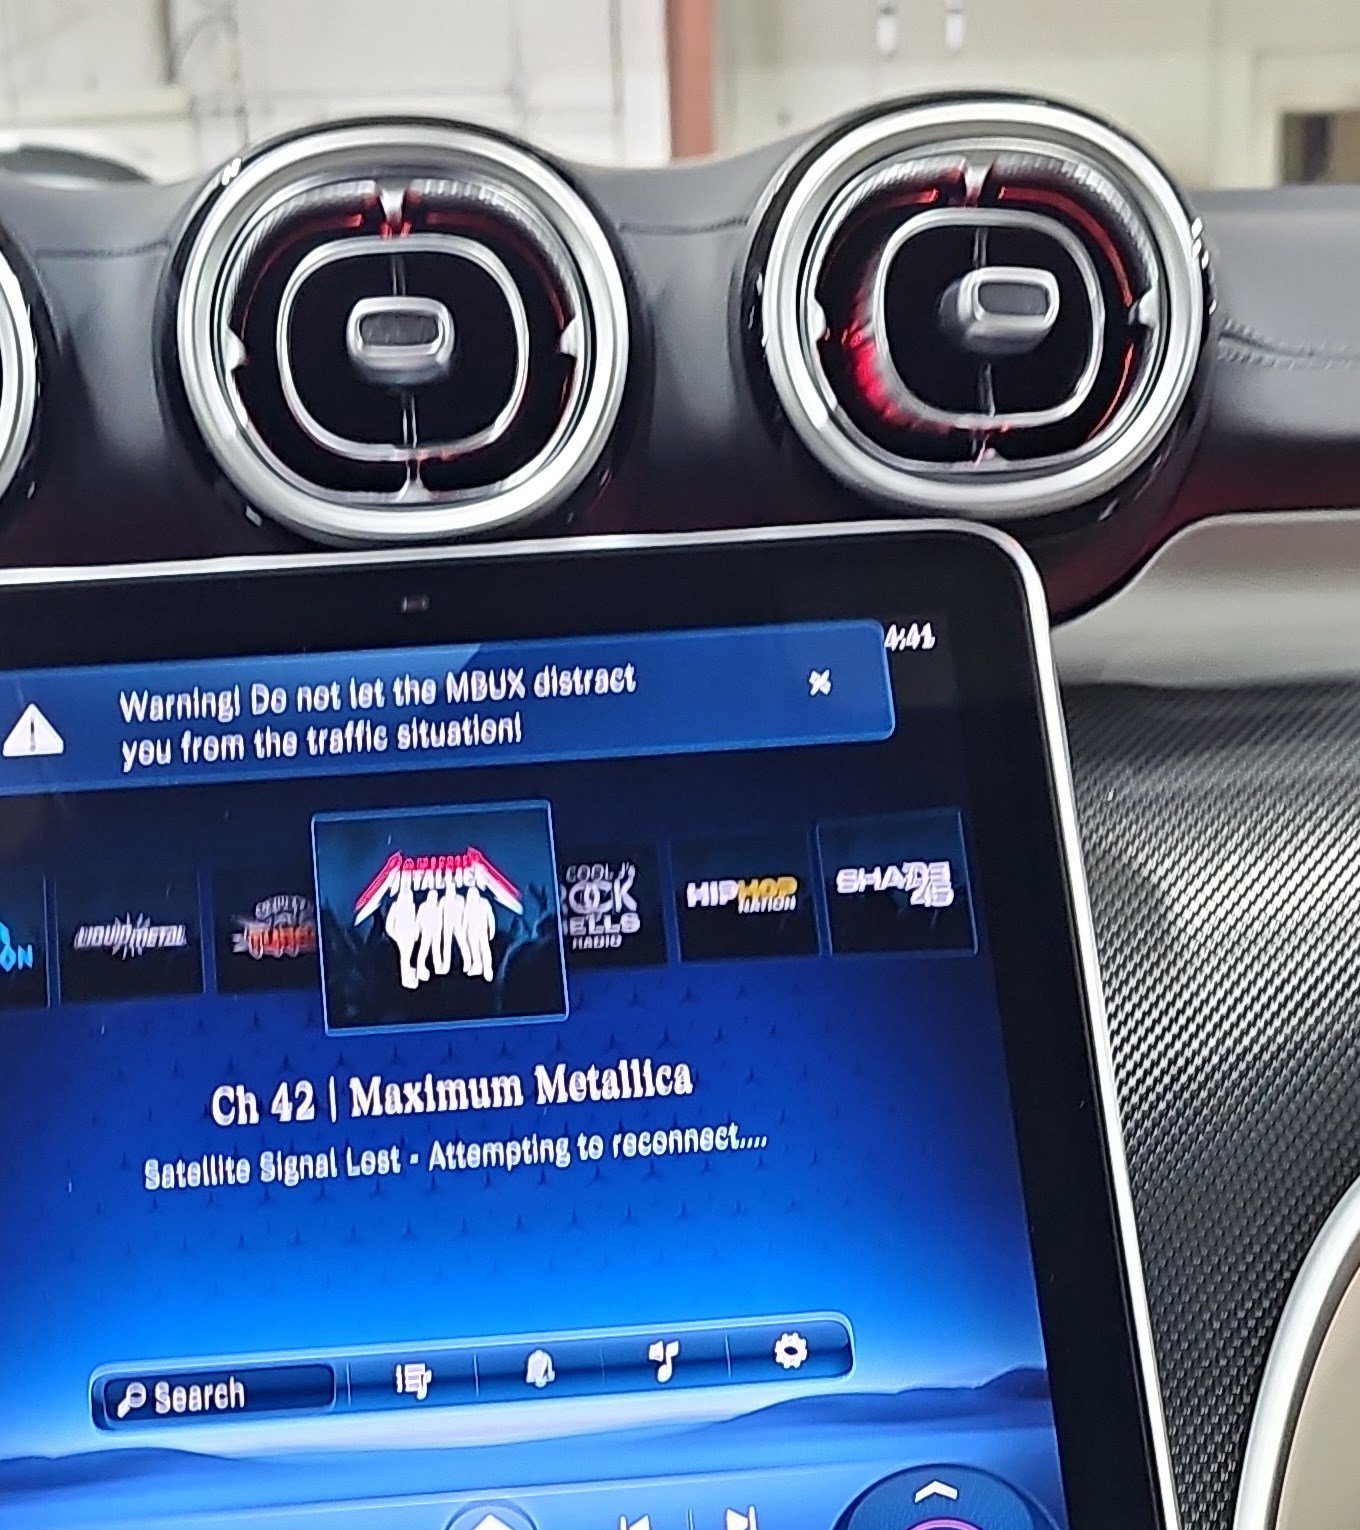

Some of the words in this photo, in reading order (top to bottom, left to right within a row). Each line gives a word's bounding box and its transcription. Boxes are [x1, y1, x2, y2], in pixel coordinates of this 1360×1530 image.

[119, 684, 241, 723] Warning!
[250, 683, 287, 716] Do
[297, 680, 341, 712] not
[348, 676, 385, 710] let
[392, 673, 437, 707] the
[445, 667, 526, 704] MBUX
[534, 662, 636, 698] distract
[122, 738, 171, 773] you
[180, 730, 244, 763] from
[254, 725, 298, 759] the
[306, 719, 388, 756] traffic
[397, 711, 522, 750] situation!
[211, 1084, 260, 1126] Ch
[271, 1080, 316, 1122] 42
[349, 1072, 524, 1118] Maximum
[534, 1058, 693, 1105] Metallica
[144, 1154, 251, 1190] Satellite
[260, 1146, 338, 1187] Signal
[347, 1145, 402, 1177] Lost
[429, 1133, 570, 1171] Attempting
[577, 1132, 604, 1160] to
[153, 1375, 245, 1415] Search
